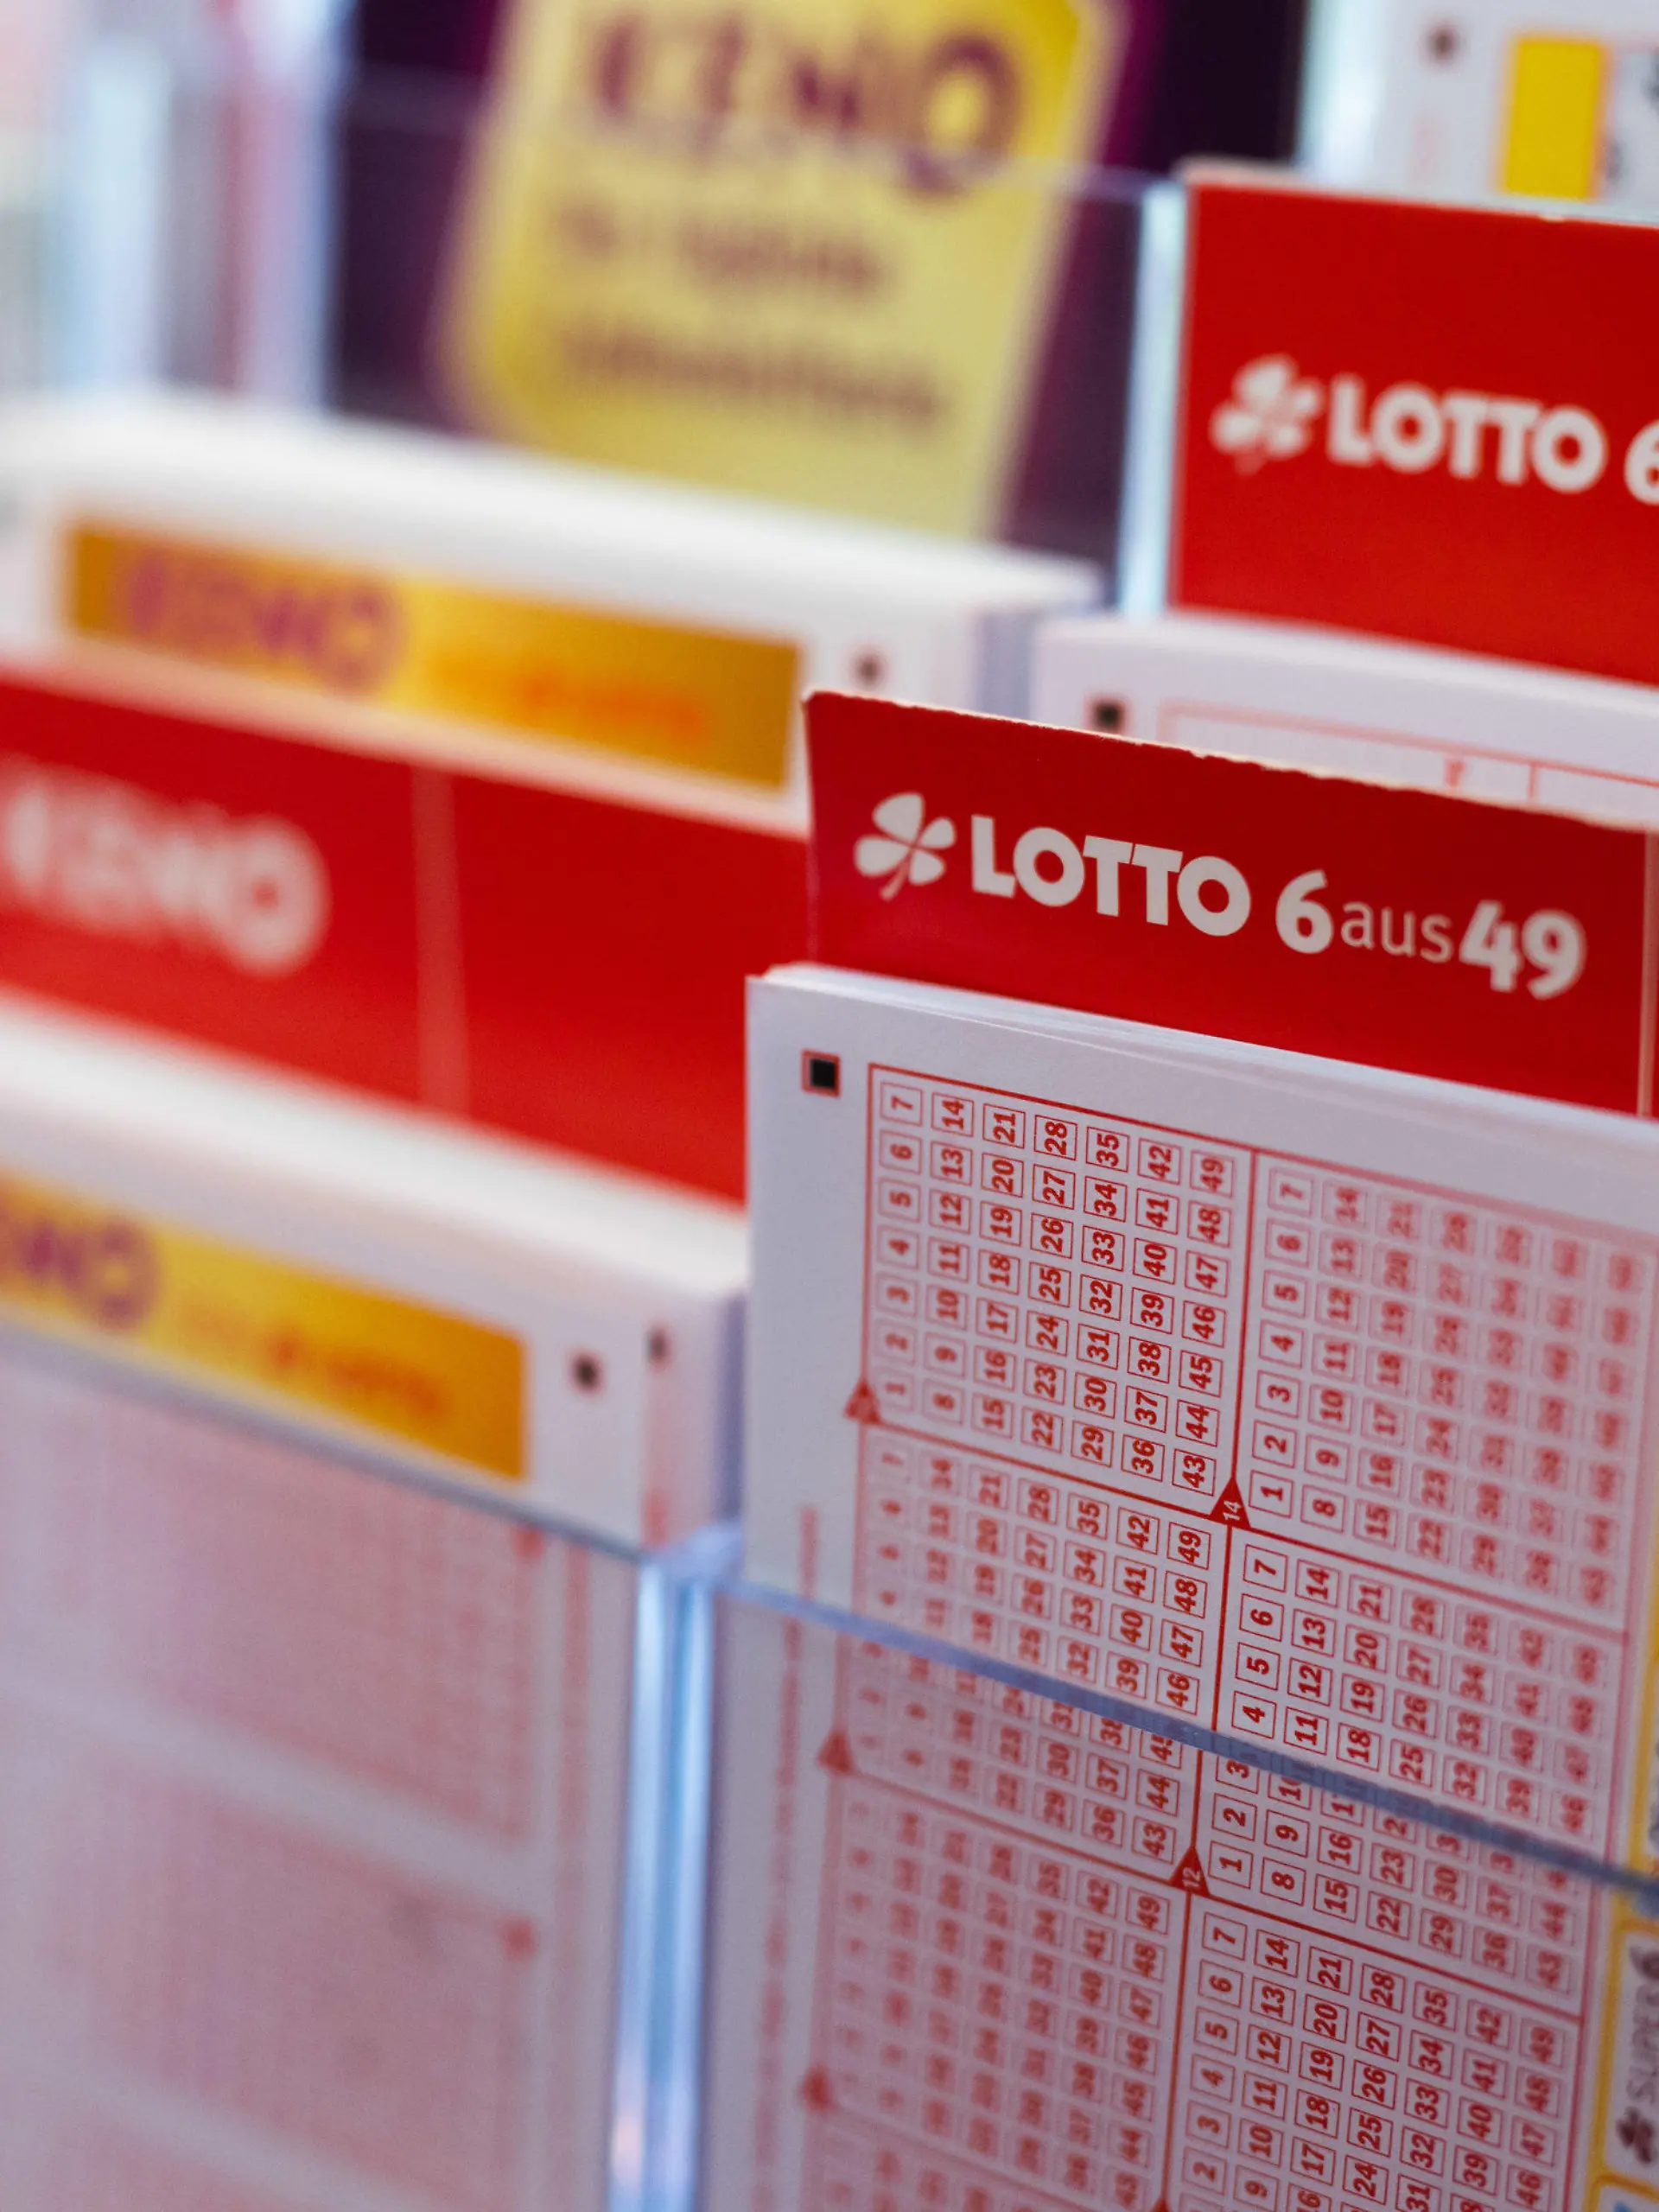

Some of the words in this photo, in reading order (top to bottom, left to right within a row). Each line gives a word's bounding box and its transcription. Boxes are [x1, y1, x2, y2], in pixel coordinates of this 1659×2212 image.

[1327, 372, 1608, 493] LOTTO
[971, 815, 1251, 936] LOTTO
[890, 1096, 913, 1110] 7
[941, 1096, 964, 1130] 14
[992, 1113, 1016, 1144] 21
[1044, 1121, 1068, 1157] 28
[940, 1147, 963, 1179] 13
[1096, 1130, 1120, 1168] 35
[1147, 1145, 1173, 1179] 42
[991, 1155, 1015, 1196] 20
[1042, 1170, 1065, 1207] 27
[1200, 1156, 1224, 1192] 49
[939, 1192, 963, 1226] 12
[1093, 1180, 1118, 1219] 34
[1145, 1198, 1170, 1230] 41
[989, 1205, 1013, 1238] 19
[1040, 1215, 1065, 1253] 26
[1198, 1207, 1222, 1243] 48
[938, 1243, 963, 1273] 11
[1091, 1230, 1116, 1265] 33
[1143, 1240, 1167, 1278] 40
[988, 1252, 1011, 1287] 18
[1038, 1265, 1062, 1302] 25
[1195, 1253, 1219, 1290] 47
[1089, 1277, 1116, 1314] 32
[1140, 1290, 1165, 1327] 39
[1274, 1284, 1299, 1302] 5
[986, 1300, 1009, 1333] 17
[1036, 1314, 1059, 1350] 24
[1192, 1303, 1217, 1340] 46
[1086, 1329, 1112, 1363] 31
[1137, 1338, 1162, 1376] 38
[1271, 1335, 1294, 1352] 4
[985, 1349, 1007, 1382] 16
[1033, 1363, 1057, 1400] 23
[1189, 1351, 1213, 1390] 45
[1084, 1374, 1108, 1412] 30
[1134, 1387, 1158, 1426] 37
[1267, 1384, 1292, 1403] 3
[1320, 1389, 1344, 1422] 10
[982, 1397, 1005, 1429] 15
[1031, 1410, 1054, 1450] 22
[1185, 1403, 1210, 1440] 44
[1081, 1424, 1104, 1461] 29
[1131, 1437, 1155, 1474] 36
[1263, 1434, 1287, 1454] 2
[1316, 1449, 1340, 1467] 9
[1182, 1450, 1206, 1489] 43
[1223, 1500, 1242, 1521] 14
[1260, 1486, 1284, 1502] 1
[1313, 1498, 1336, 1518] 8
[1077, 1500, 1101, 1537] 35
[1127, 1515, 1151, 1552] 42
[1178, 1530, 1202, 1566] 49
[1073, 1549, 1096, 1586] 34
[1123, 1567, 1147, 1599] 41
[1254, 1559, 1277, 1576] 7
[1306, 1567, 1330, 1599] 14
[1071, 1594, 1094, 1632] 33
[1173, 1578, 1198, 1616] 48
[1357, 1586, 1383, 1621] 21
[1120, 1608, 1144, 1647] 40
[1249, 1608, 1274, 1626] 6
[1301, 1617, 1326, 1649] 13
[1170, 1624, 1194, 1660] 47
[1354, 1631, 1379, 1670] 20
[1116, 1656, 1141, 1694] 39
[1246, 1656, 1270, 1675] 5
[1298, 1662, 1324, 1698] 12
[1407, 1647, 1431, 1687] 27
[1166, 1670, 1191, 1708] 46
[1351, 1679, 1376, 1713] 19
[1242, 1706, 1266, 1724] 4
[1294, 1714, 1323, 1746] 11
[1402, 1694, 1428, 1735] 26
[1346, 1726, 1372, 1764] 18
[1399, 1744, 1424, 1782] 25
[1096, 1756, 1120, 1794] 37
[1225, 1759, 1250, 1779] 3
[1147, 1773, 1171, 1812] 44
[1223, 1808, 1246, 1827] 2
[1274, 1824, 1300, 1842] 9
[1142, 1822, 1166, 1859] 43
[1328, 1830, 1353, 1866] 16
[1182, 1867, 1201, 1887] 12
[1219, 1857, 1243, 1872] 1
[1271, 1871, 1295, 1891] 8
[1380, 1847, 1405, 1886] 23
[1324, 1878, 1349, 1914] 15
[1433, 1865, 1459, 1904] 30
[1136, 1896, 1160, 1931] 49
[1376, 1895, 1403, 1934] 22
[1212, 1927, 1236, 1945] 7
[1429, 1915, 1454, 1954] 29
[1265, 1936, 1289, 1970] 14
[1209, 1975, 1232, 1993] 6
[1317, 1956, 1343, 1993] 21
[1370, 1971, 1395, 2011] 28
[1261, 1986, 1286, 2018] 13
[1422, 1989, 1448, 2028] 35
[1205, 2022, 1229, 2040] 5
[1313, 2002, 1338, 2041] 20
[1363, 2019, 1390, 2059] 27
[1477, 2007, 1502, 2045] 42
[1256, 2030, 1283, 2064] 12
[1309, 2048, 1334, 2082] 19
[1418, 2039, 1444, 2078] 34
[1201, 2069, 1224, 2087] 4
[1361, 2065, 1387, 2106] 26
[1471, 2060, 1497, 2094] 41
[1253, 2081, 1278, 2111] 11
[1305, 2094, 1330, 2130] 18
[1414, 2084, 1440, 2124] 33
[1197, 2115, 1221, 2134] 3
[1249, 2122, 1274, 2158] 10
[1357, 2113, 1382, 2151] 25
[1467, 2102, 1492, 2142] 40
[1300, 2142, 1325, 2176] 17
[1409, 2131, 1437, 2171] 32
[1245, 2180, 1268, 2198] 9
[1352, 2161, 1377, 2199] 24
[1463, 2152, 1488, 2190] 39
[1405, 2183, 1433, 2212] 31
